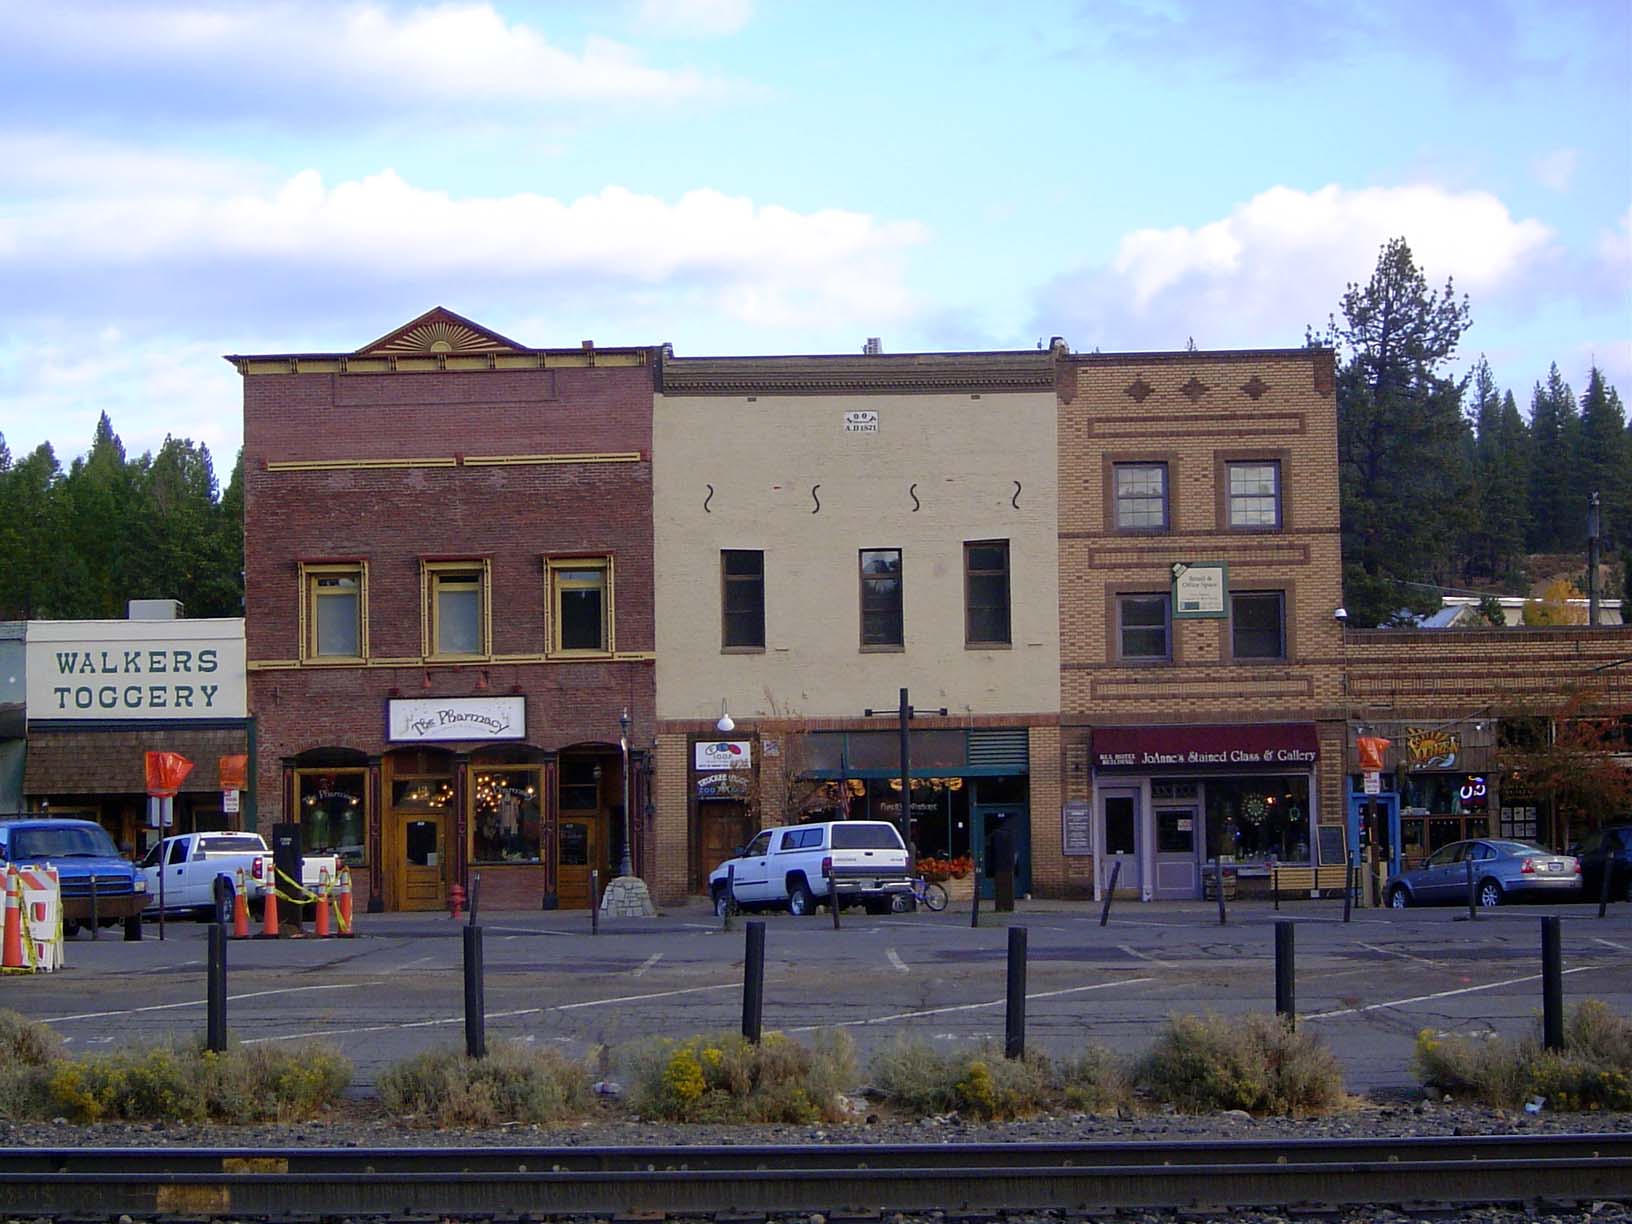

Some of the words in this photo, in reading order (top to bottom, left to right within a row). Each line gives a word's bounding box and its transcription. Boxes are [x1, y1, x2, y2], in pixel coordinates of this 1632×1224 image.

[56, 650, 219, 674] WALKERS
[54, 685, 218, 709] TOGGERY
[411, 718, 435, 736] The
[437, 709, 510, 735] Pharmacy
[1188, 751, 1226, 763] Stained
[1230, 750, 1260, 762] Glass
[1263, 750, 1274, 761] &
[1277, 749, 1316, 762] Gallery
